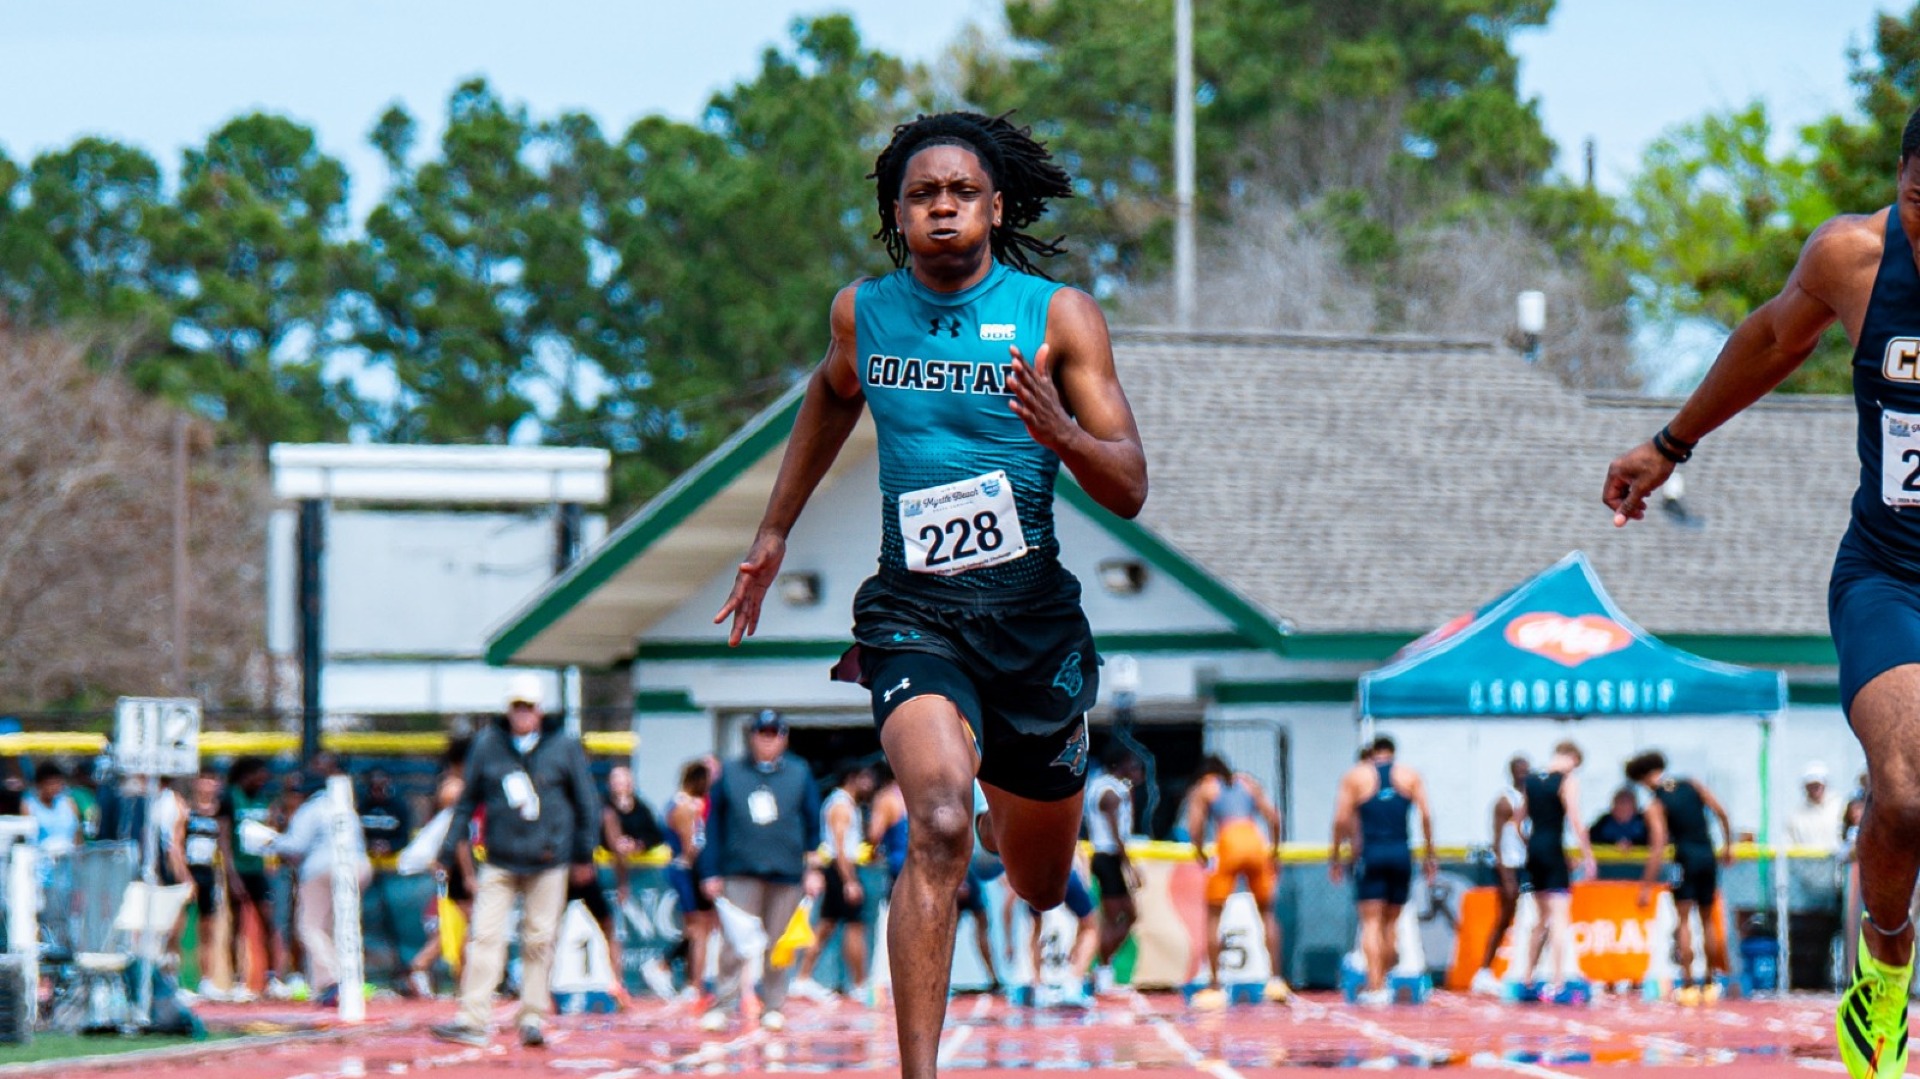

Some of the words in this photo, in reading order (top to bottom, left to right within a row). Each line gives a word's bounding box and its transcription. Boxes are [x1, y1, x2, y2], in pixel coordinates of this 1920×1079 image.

[1882, 337, 1920, 383] C
[920, 510, 1004, 567] 228
[1469, 679, 1675, 714] LEADERSHIP
[1222, 930, 1247, 969] 5
